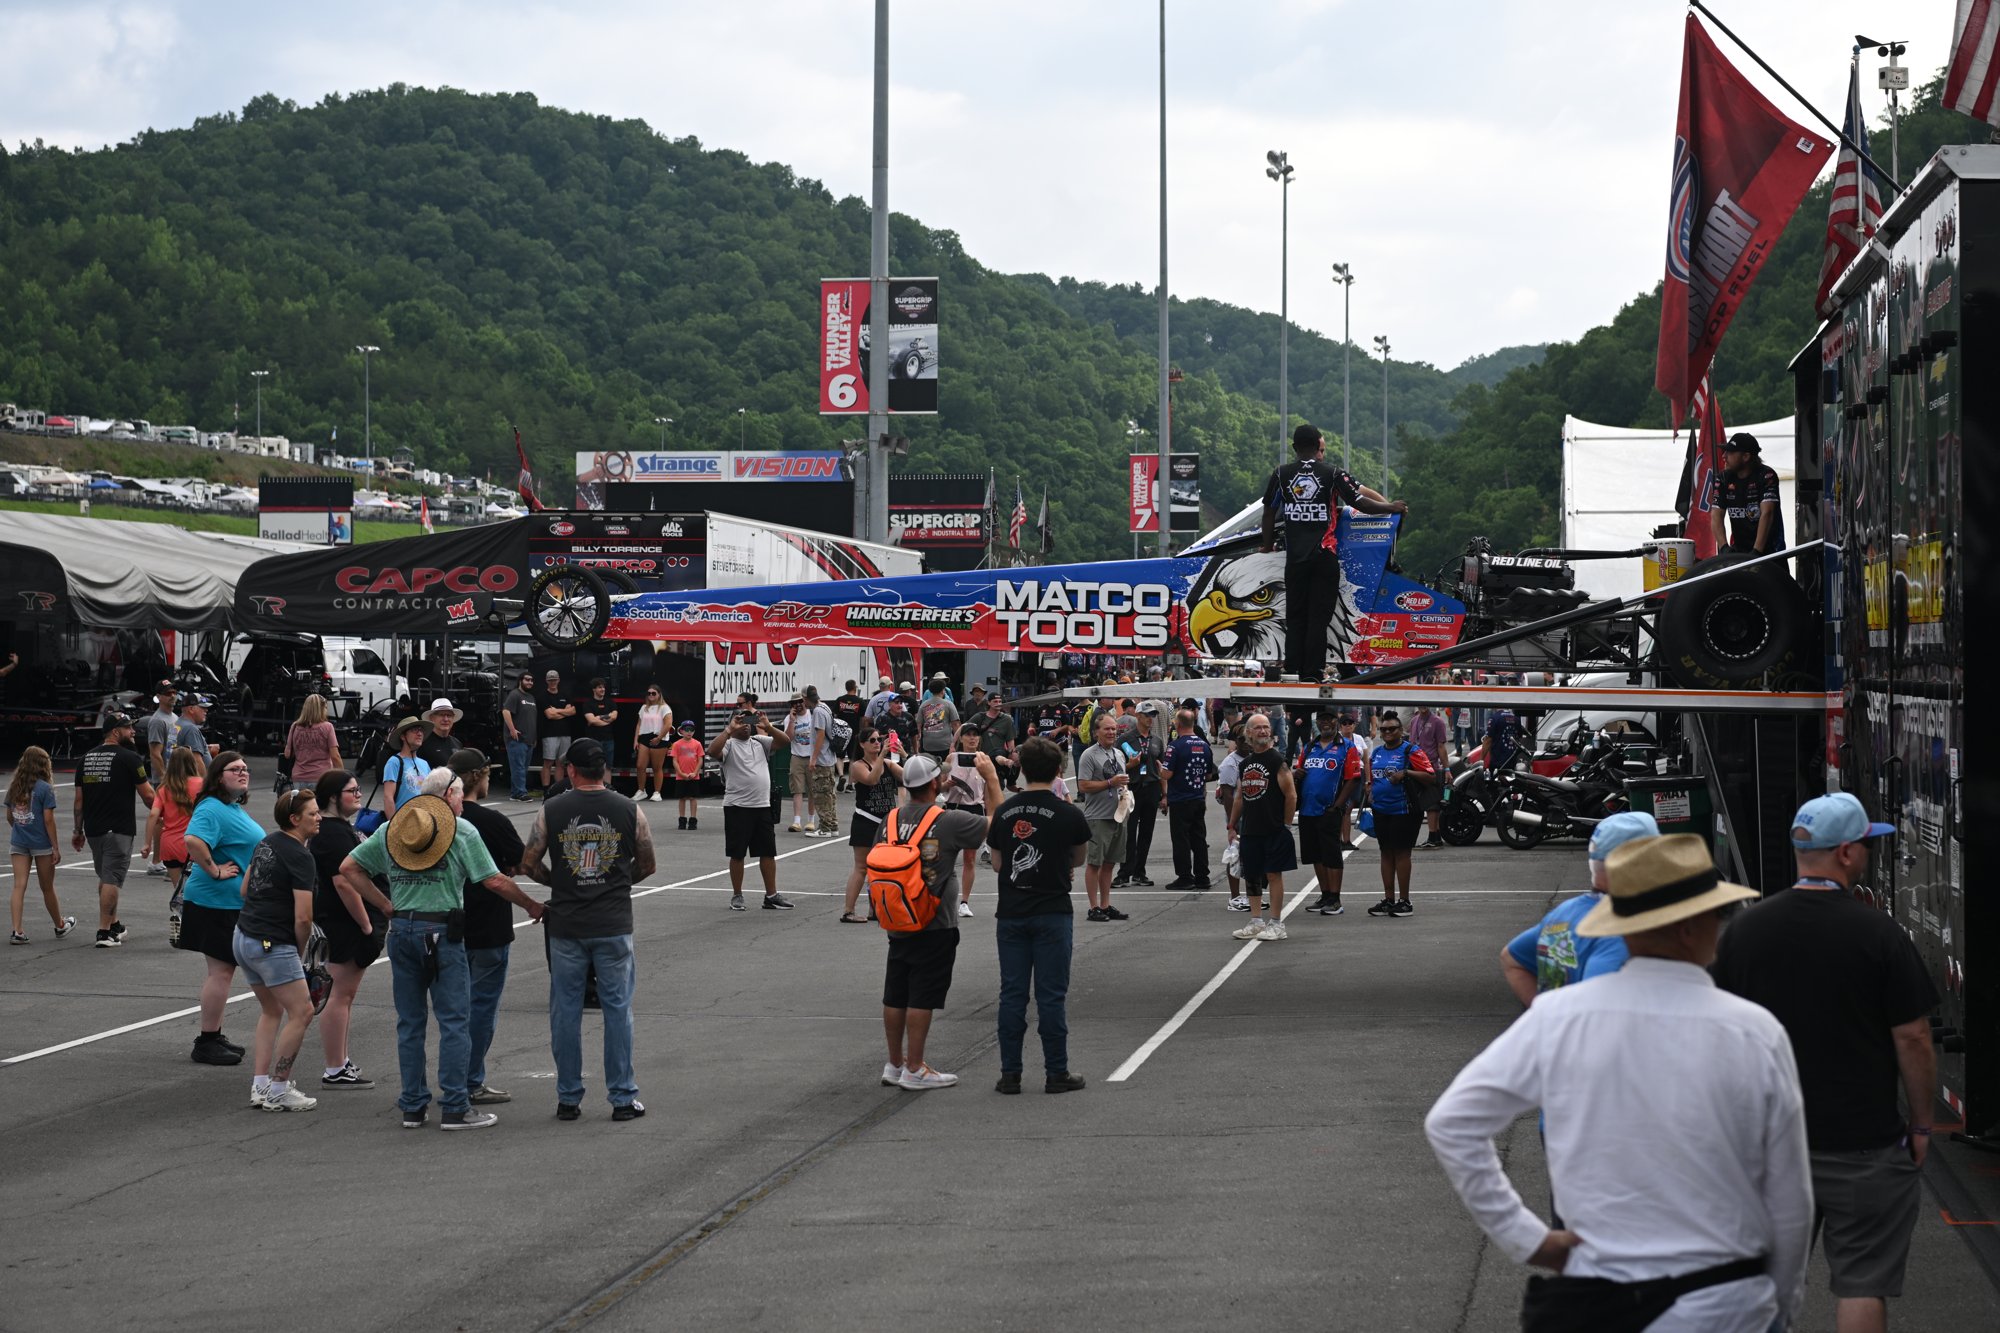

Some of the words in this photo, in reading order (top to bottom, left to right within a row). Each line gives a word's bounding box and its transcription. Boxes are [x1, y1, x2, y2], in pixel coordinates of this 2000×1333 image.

[1694, 187, 1760, 283] HART
[1728, 238, 1768, 296] FUEL
[826, 292, 841, 372] THUNDER
[840, 312, 852, 370] VALLEY
[828, 374, 857, 408] 6
[635, 453, 718, 474] Strange
[734, 456, 838, 478] VISION
[1132, 462, 1142, 508] THUNDER
[1140, 473, 1148, 506] VALLEY
[1284, 503, 1327, 512] MATCO
[1285, 512, 1328, 521] TOOLS
[661, 522, 682, 532] MAC
[890, 513, 982, 528] SUPERGRIP
[1134, 508, 1152, 529] 7
[579, 559, 657, 570] CAPCO
[1492, 557, 1514, 566] RED
[1516, 557, 1542, 568] LINE
[1545, 559, 1562, 568] OIL
[336, 565, 518, 593] CAPCO
[996, 580, 1170, 614] MATCO
[447, 598, 475, 619] wt
[630, 608, 682, 622] Scouting
[701, 611, 750, 622] America
[763, 604, 832, 620] FVP
[846, 607, 976, 622] HANGSTERFER'S
[996, 612, 1168, 646] TOOLS
[713, 671, 778, 694] CONTRACTORS
[782, 672, 798, 692] INC.
[558, 832, 622, 842] HARLEY-DAVIDSON
